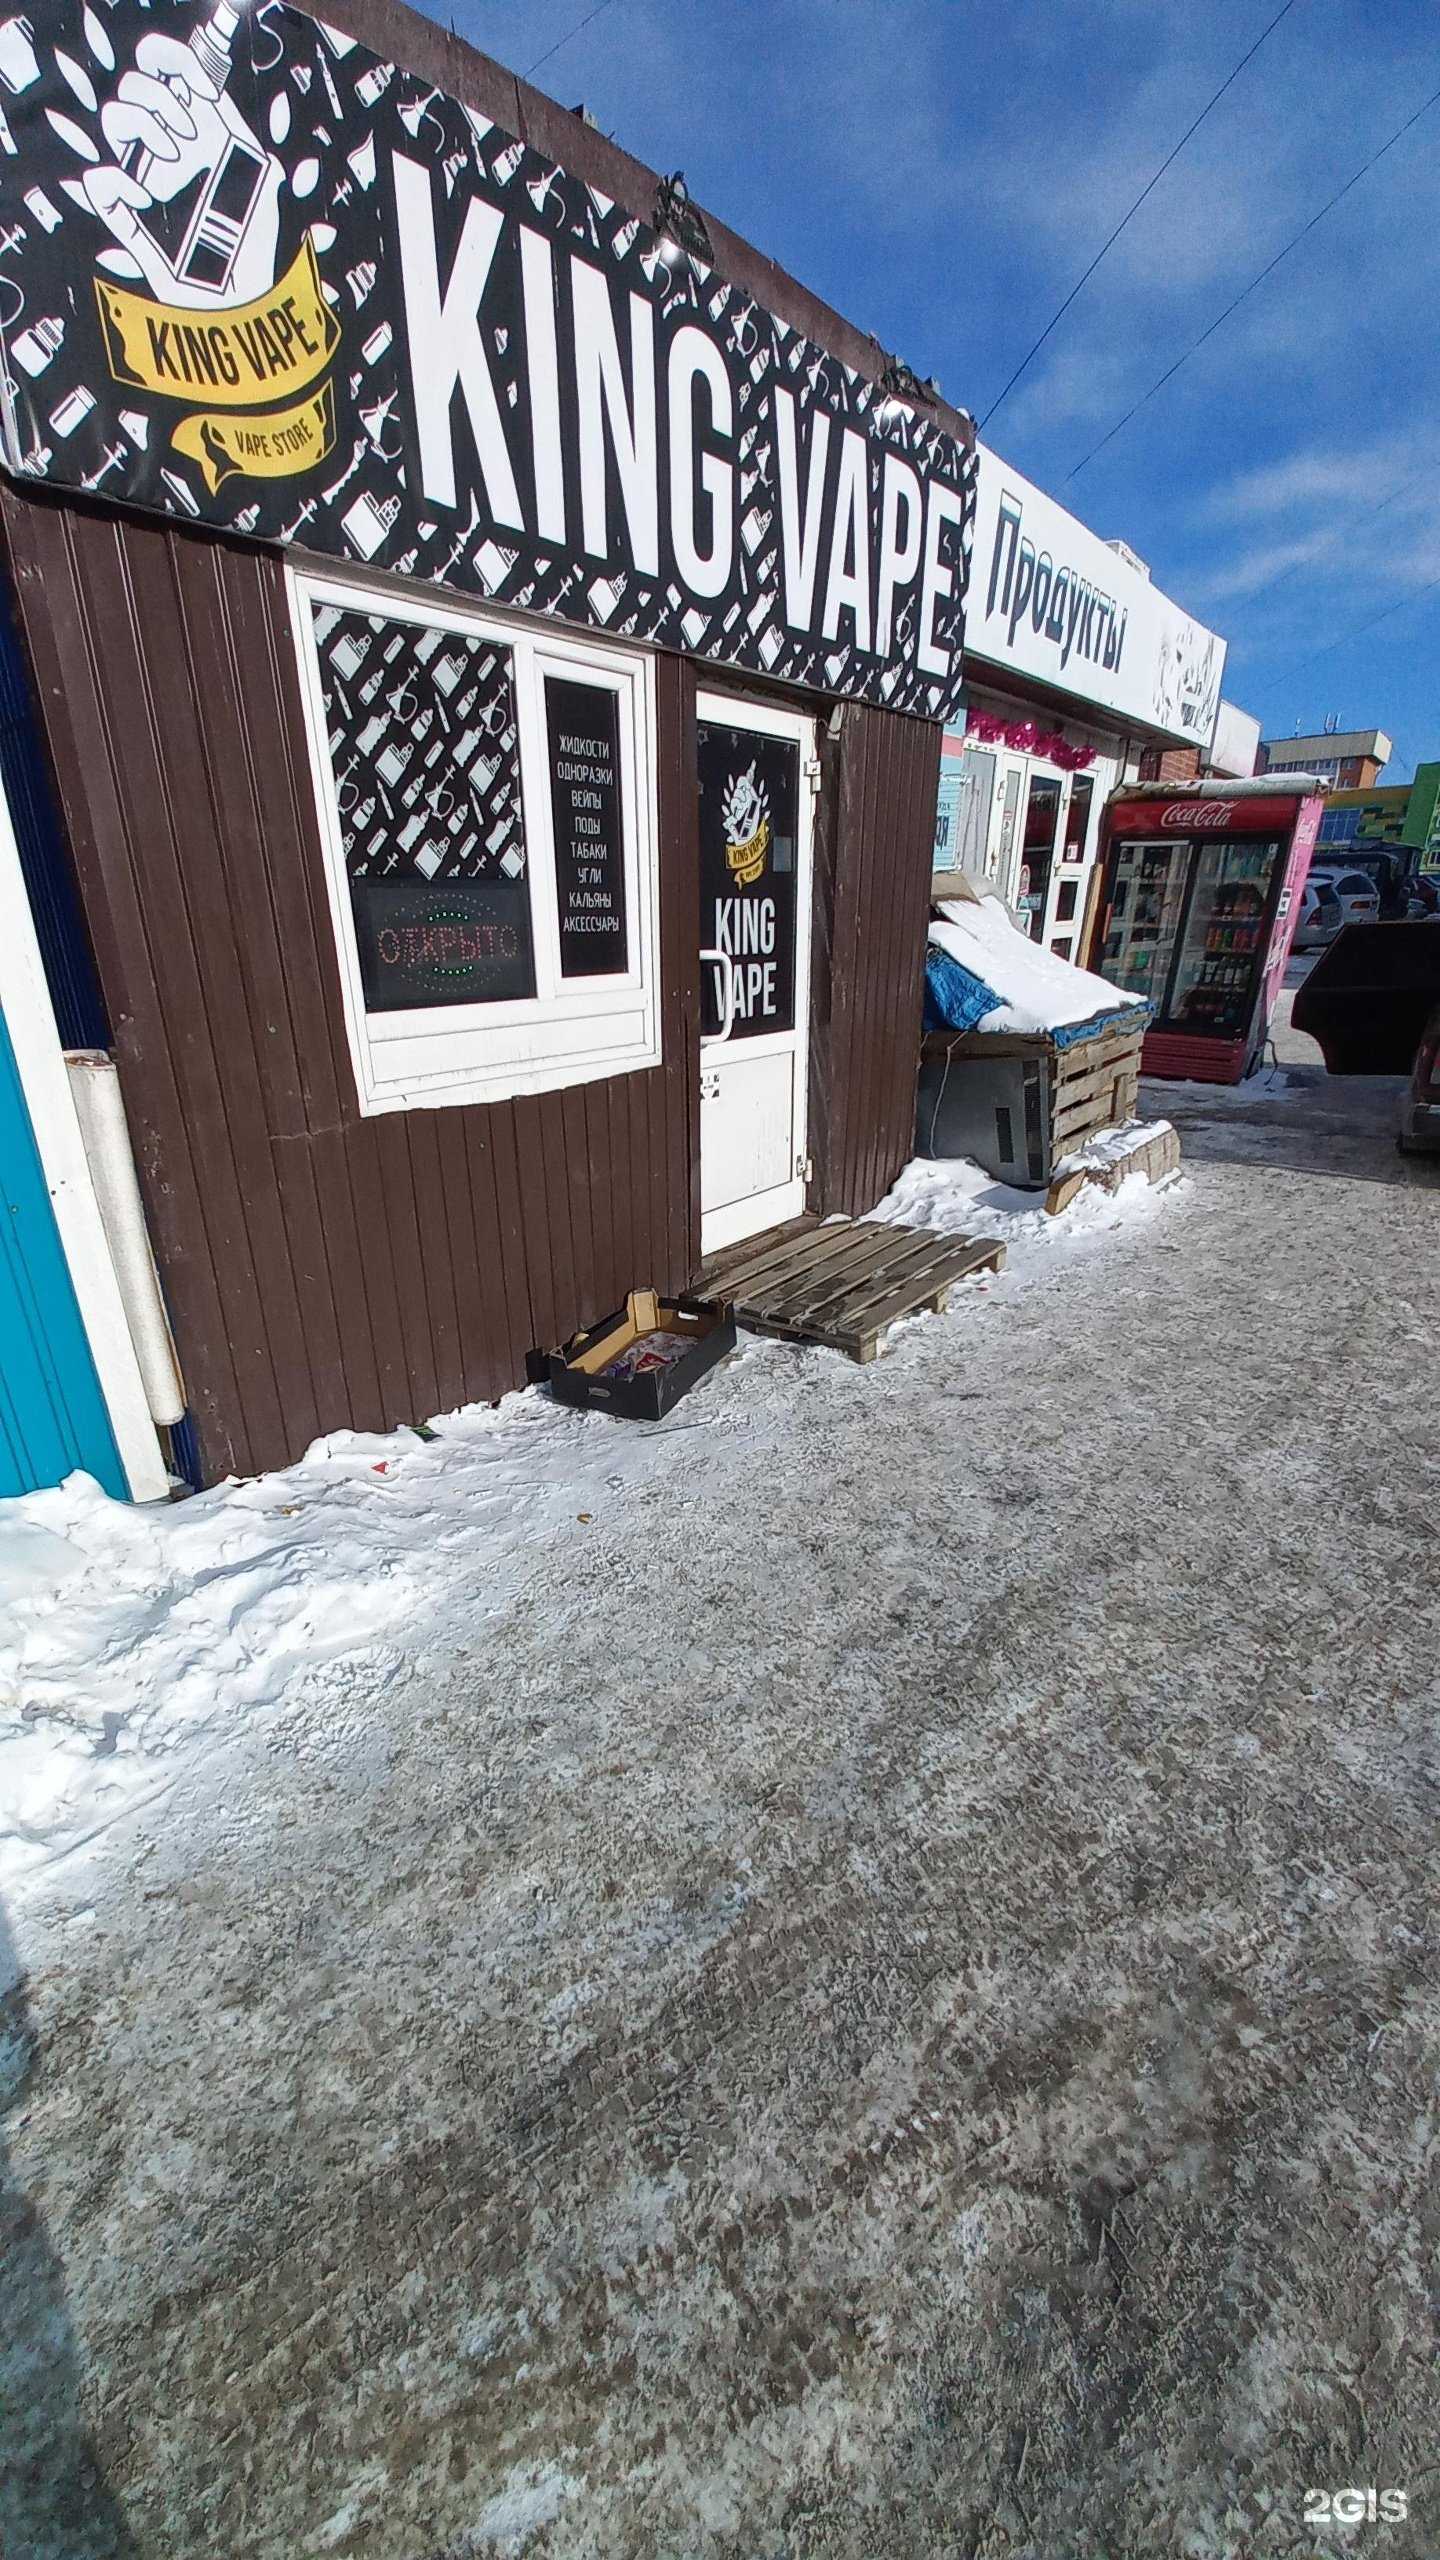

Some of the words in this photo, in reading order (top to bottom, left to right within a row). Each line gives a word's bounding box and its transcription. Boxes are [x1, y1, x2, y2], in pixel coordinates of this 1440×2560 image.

[146, 316, 240, 386] KING
[231, 296, 319, 381] VAPE
[392, 150, 733, 598] KING
[775, 384, 962, 678] VAPE
[234, 430, 271, 458] VAPE
[271, 417, 313, 456] STORE
[985, 488, 1129, 673] Продукты
[559, 734, 609, 760] ЖИДКОСТИ
[557, 762, 613, 786] ОДНОРАЗКИ
[571, 789, 602, 810] ВЕЙПЫ
[575, 816, 601, 835] ПОДЫ
[570, 841, 607, 860] ТАБАКИ
[577, 867, 602, 884] УГЛИ
[569, 892, 612, 909] КАЛЬЯНЫ
[563, 916, 620, 933] АКСЕССУАРЫ
[715, 898, 775, 956] KING
[377, 924, 518, 964] ОТКРЫТО
